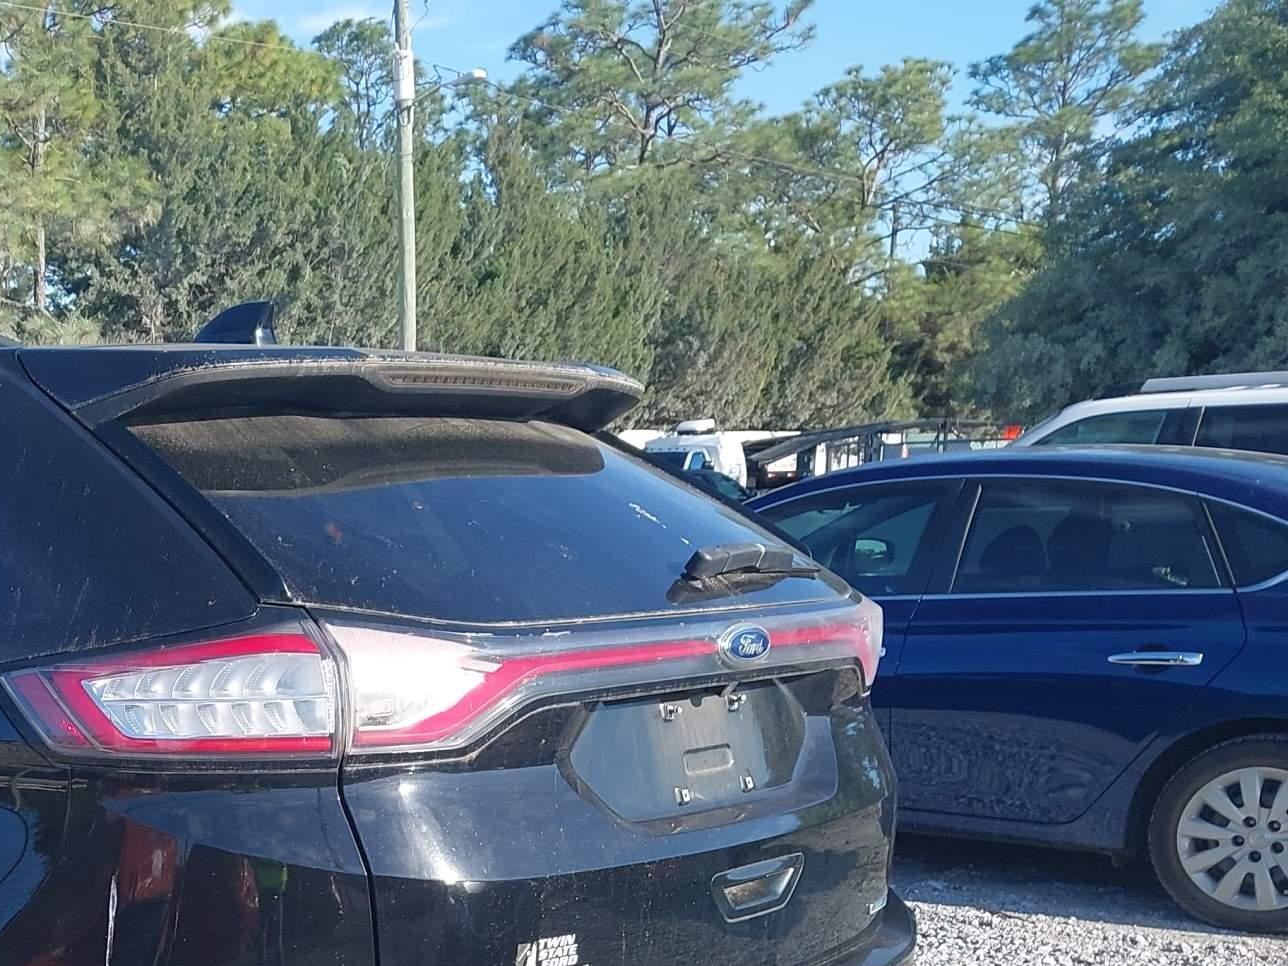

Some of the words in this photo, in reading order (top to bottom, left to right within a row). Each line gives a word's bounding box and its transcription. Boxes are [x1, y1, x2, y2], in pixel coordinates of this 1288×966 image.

[739, 633, 764, 656] Ford
[538, 934, 576, 950] TWIN
[538, 944, 578, 961] STATE
